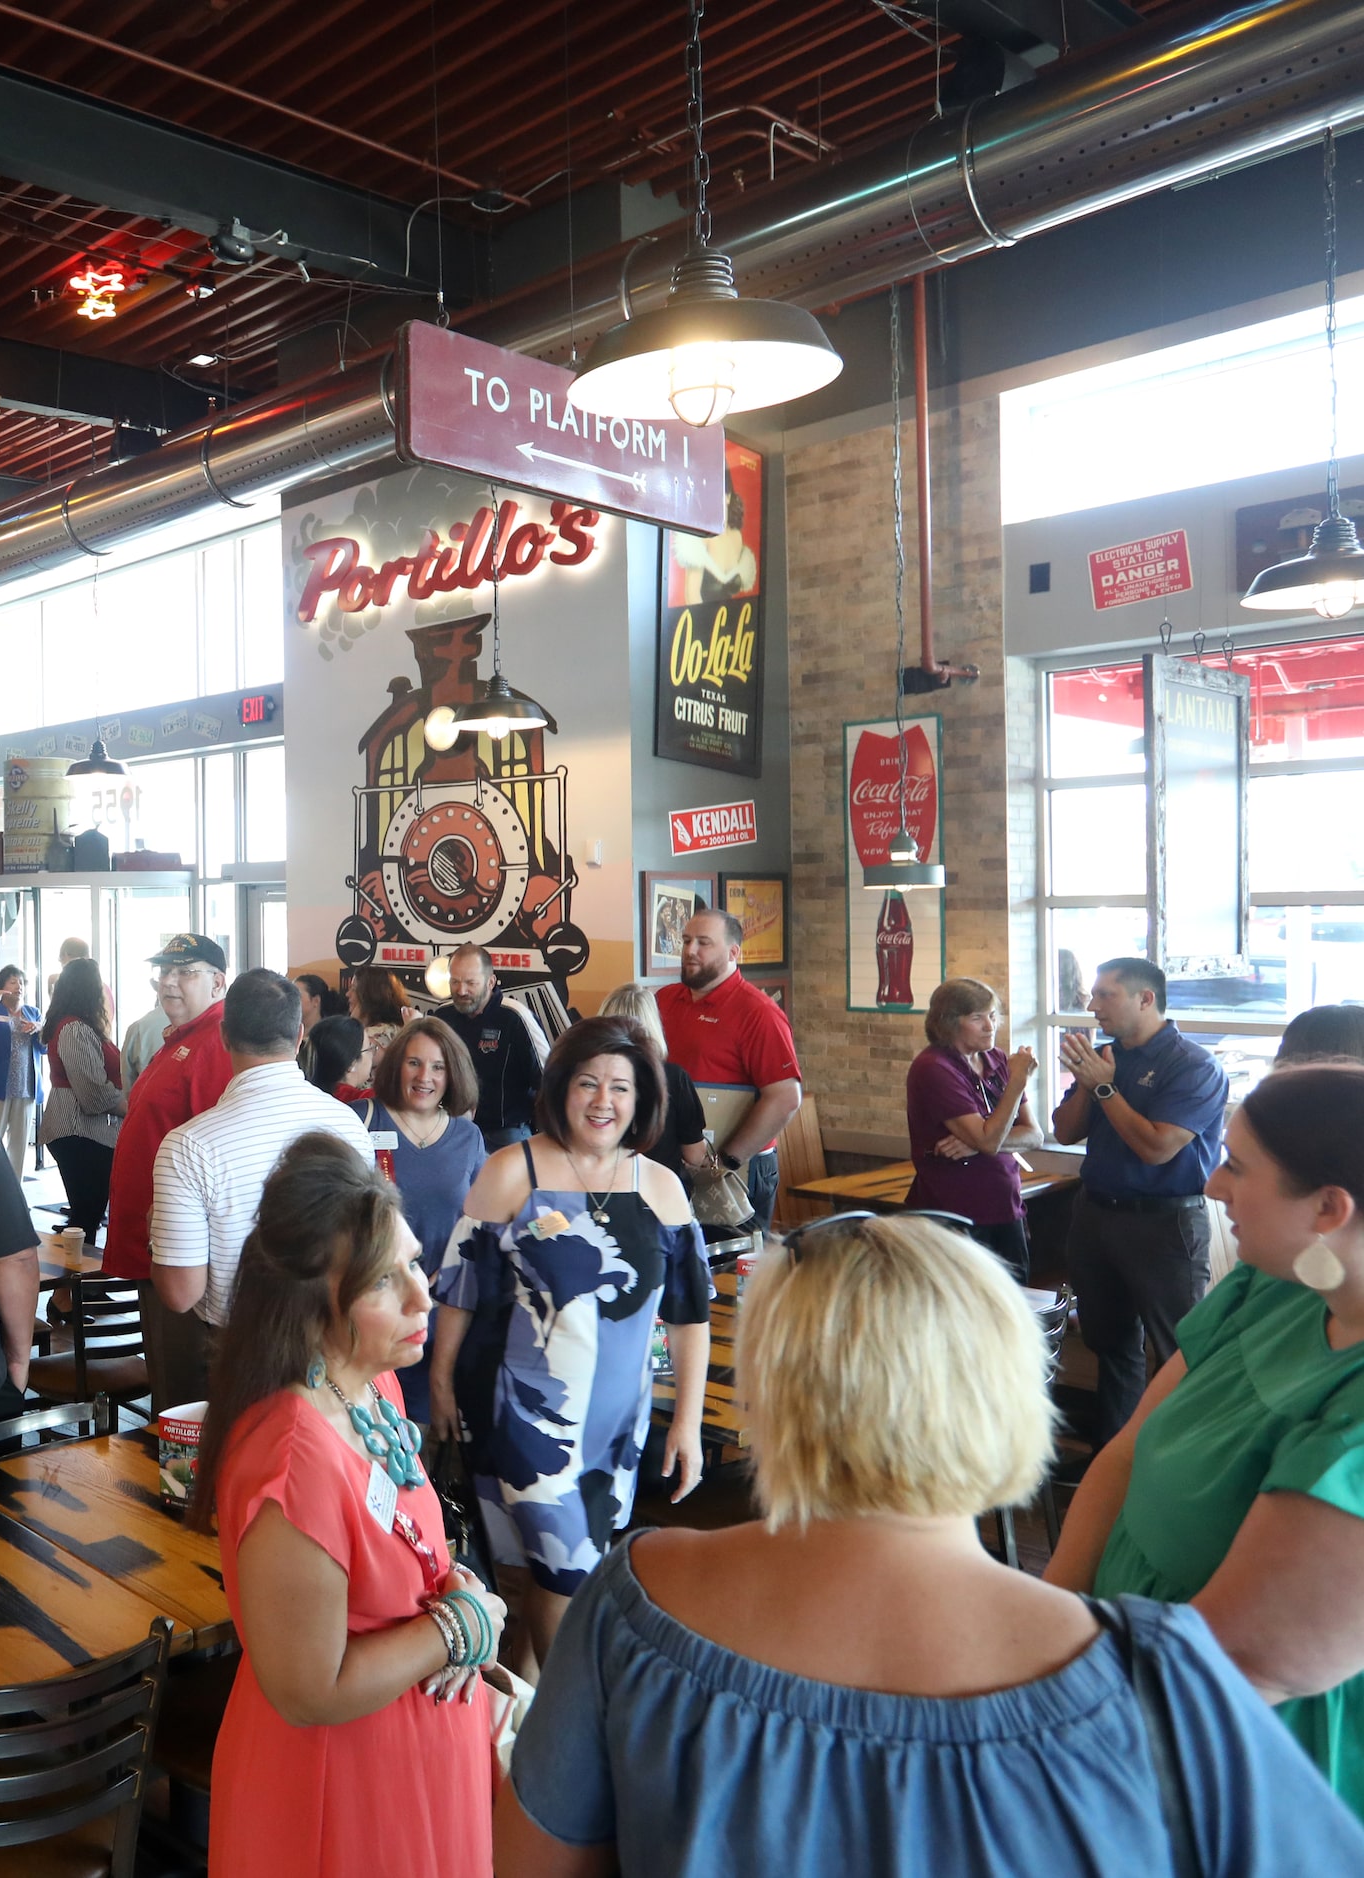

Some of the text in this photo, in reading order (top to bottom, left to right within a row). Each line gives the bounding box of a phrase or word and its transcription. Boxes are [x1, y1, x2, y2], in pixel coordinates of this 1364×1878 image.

[464, 367, 511, 413] TO
[530, 387, 666, 462] PLATFORM
[298, 499, 601, 623] Portillo's
[1095, 533, 1179, 564] ELECTRICAL SUPPLY
[1112, 548, 1164, 569] STATION
[1101, 558, 1179, 588] DANGER
[242, 695, 265, 724] EXIT
[701, 688, 727, 703] TEXAS
[674, 696, 749, 736] CITRUS FRUIT
[1165, 688, 1236, 737] LANTANA
[6, 800, 38, 818] Skelly
[691, 805, 754, 838] KENDALL
[863, 808, 924, 820] ENJOY HAT
[709, 836, 726, 846] 2000
[740, 832, 750, 841] OIL
[863, 847, 884, 856] NEW
[381, 947, 425, 962] ALLEN
